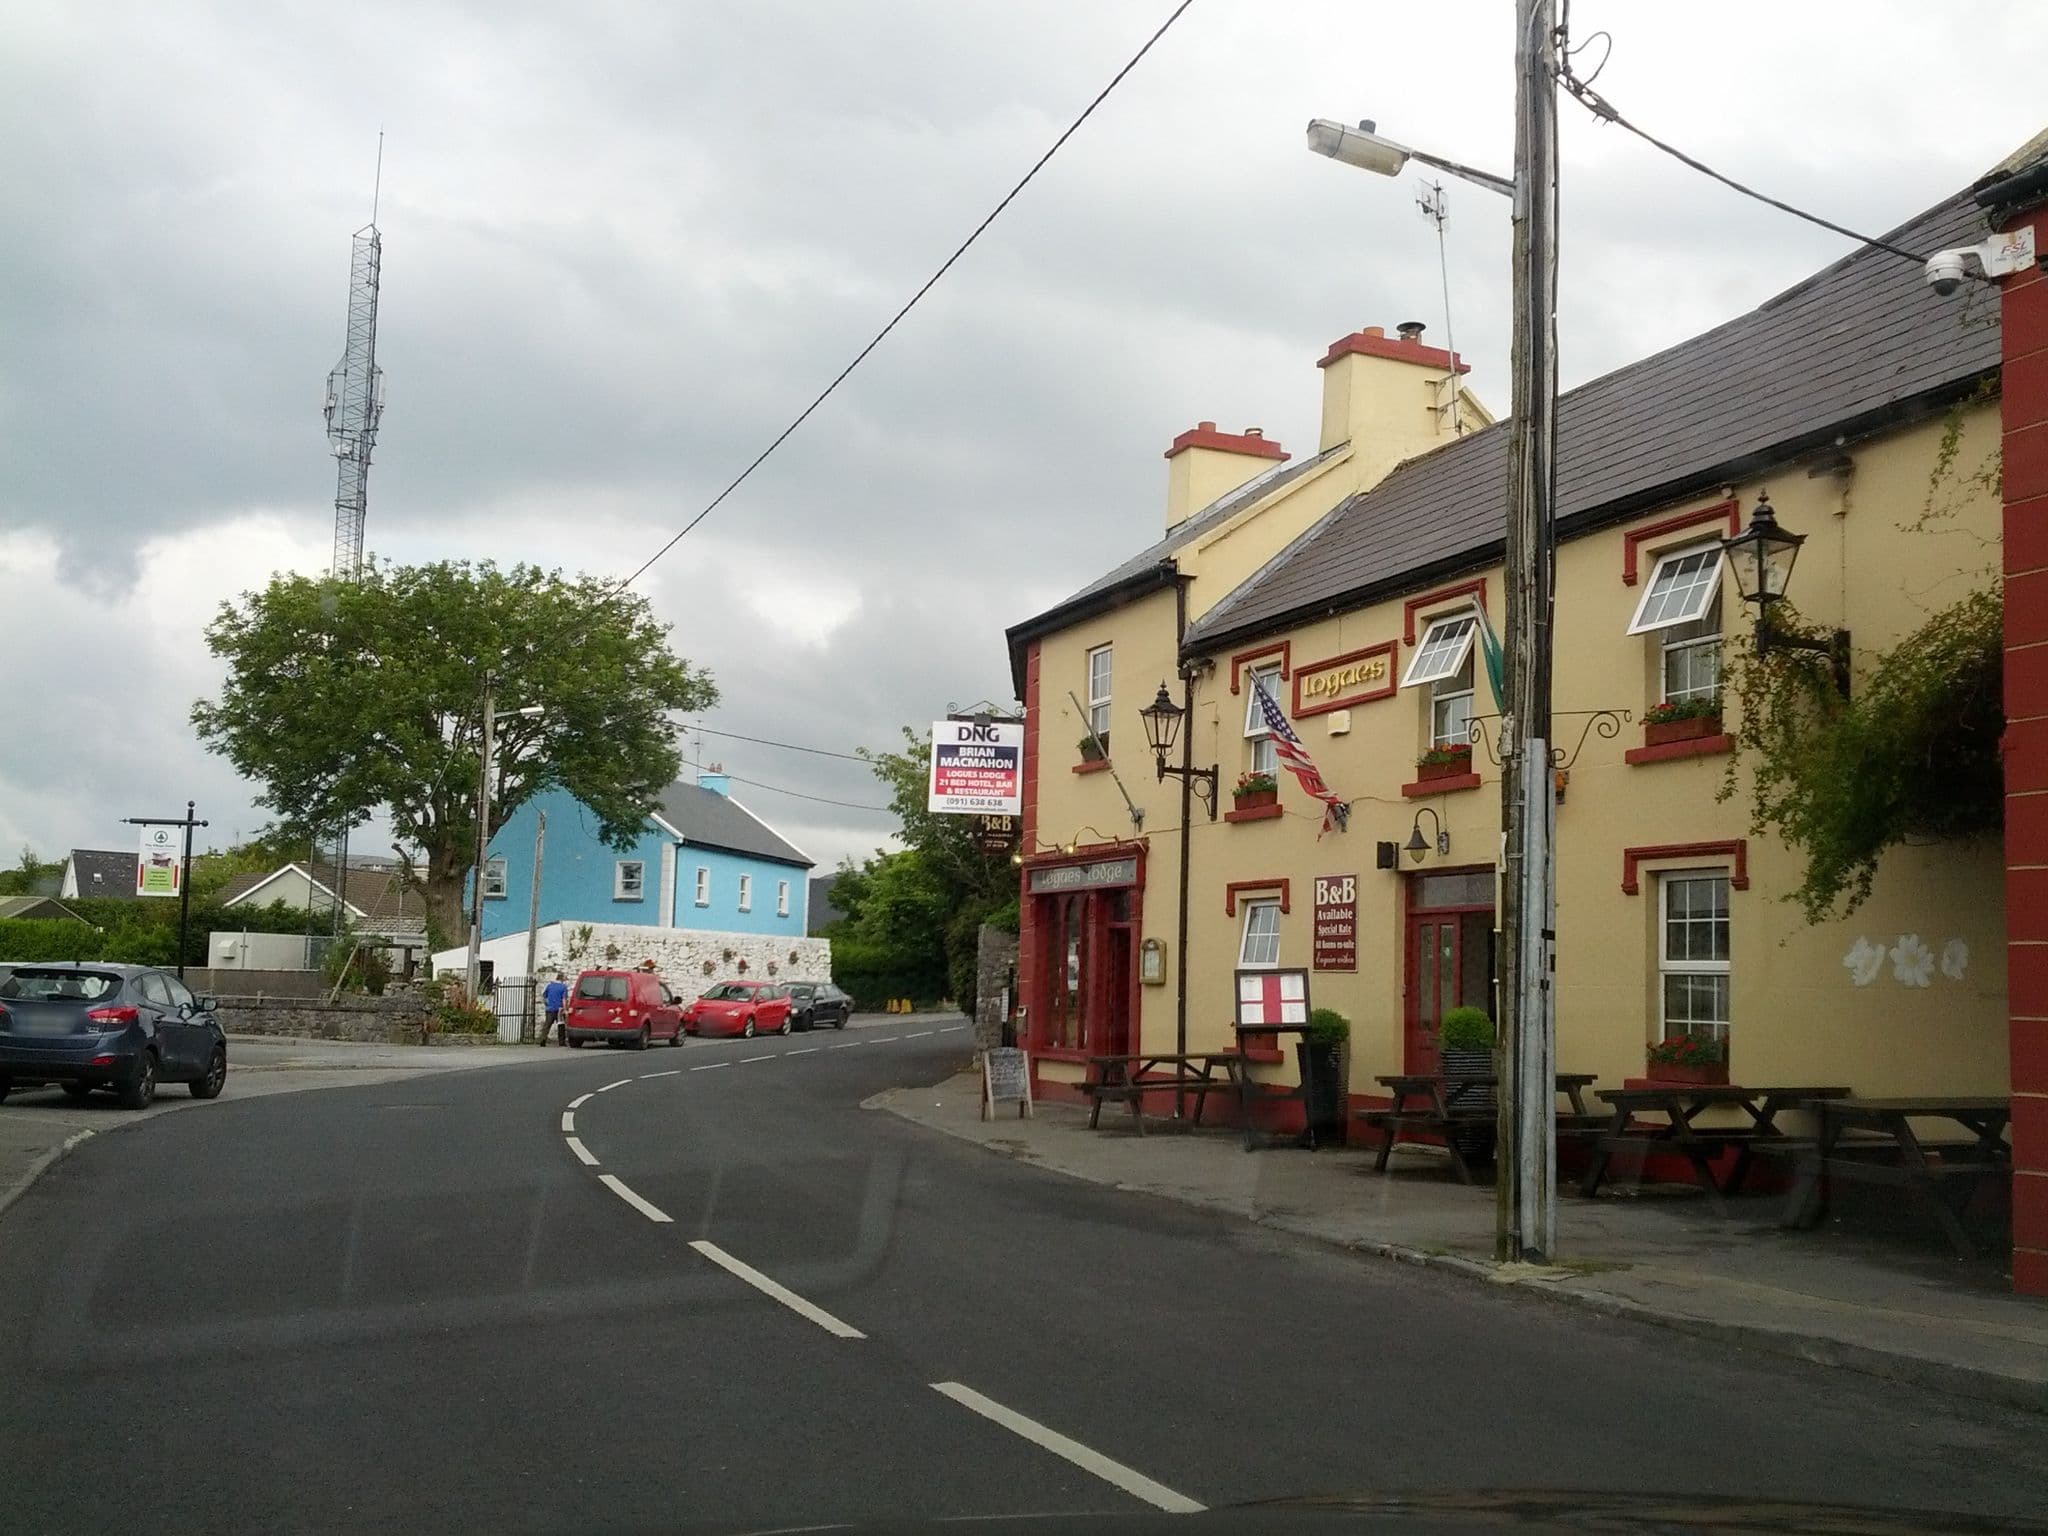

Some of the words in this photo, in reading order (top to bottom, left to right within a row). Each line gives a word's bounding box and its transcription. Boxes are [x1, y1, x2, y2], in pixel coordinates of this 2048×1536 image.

[958, 726, 1000, 743] DNG
[959, 746, 995, 757] BRIAN
[940, 757, 1013, 769] MACMAHON
[946, 770, 978, 779] LOGUES
[979, 771, 1006, 779] LODGE
[939, 778, 949, 787] 21
[950, 779, 967, 787] BED
[955, 788, 1005, 796] RESTAURANT
[946, 797, 968, 807] (091)
[1316, 878, 1356, 905] B&B
[1317, 908, 1353, 921] Available
[1318, 924, 1337, 937] Special
